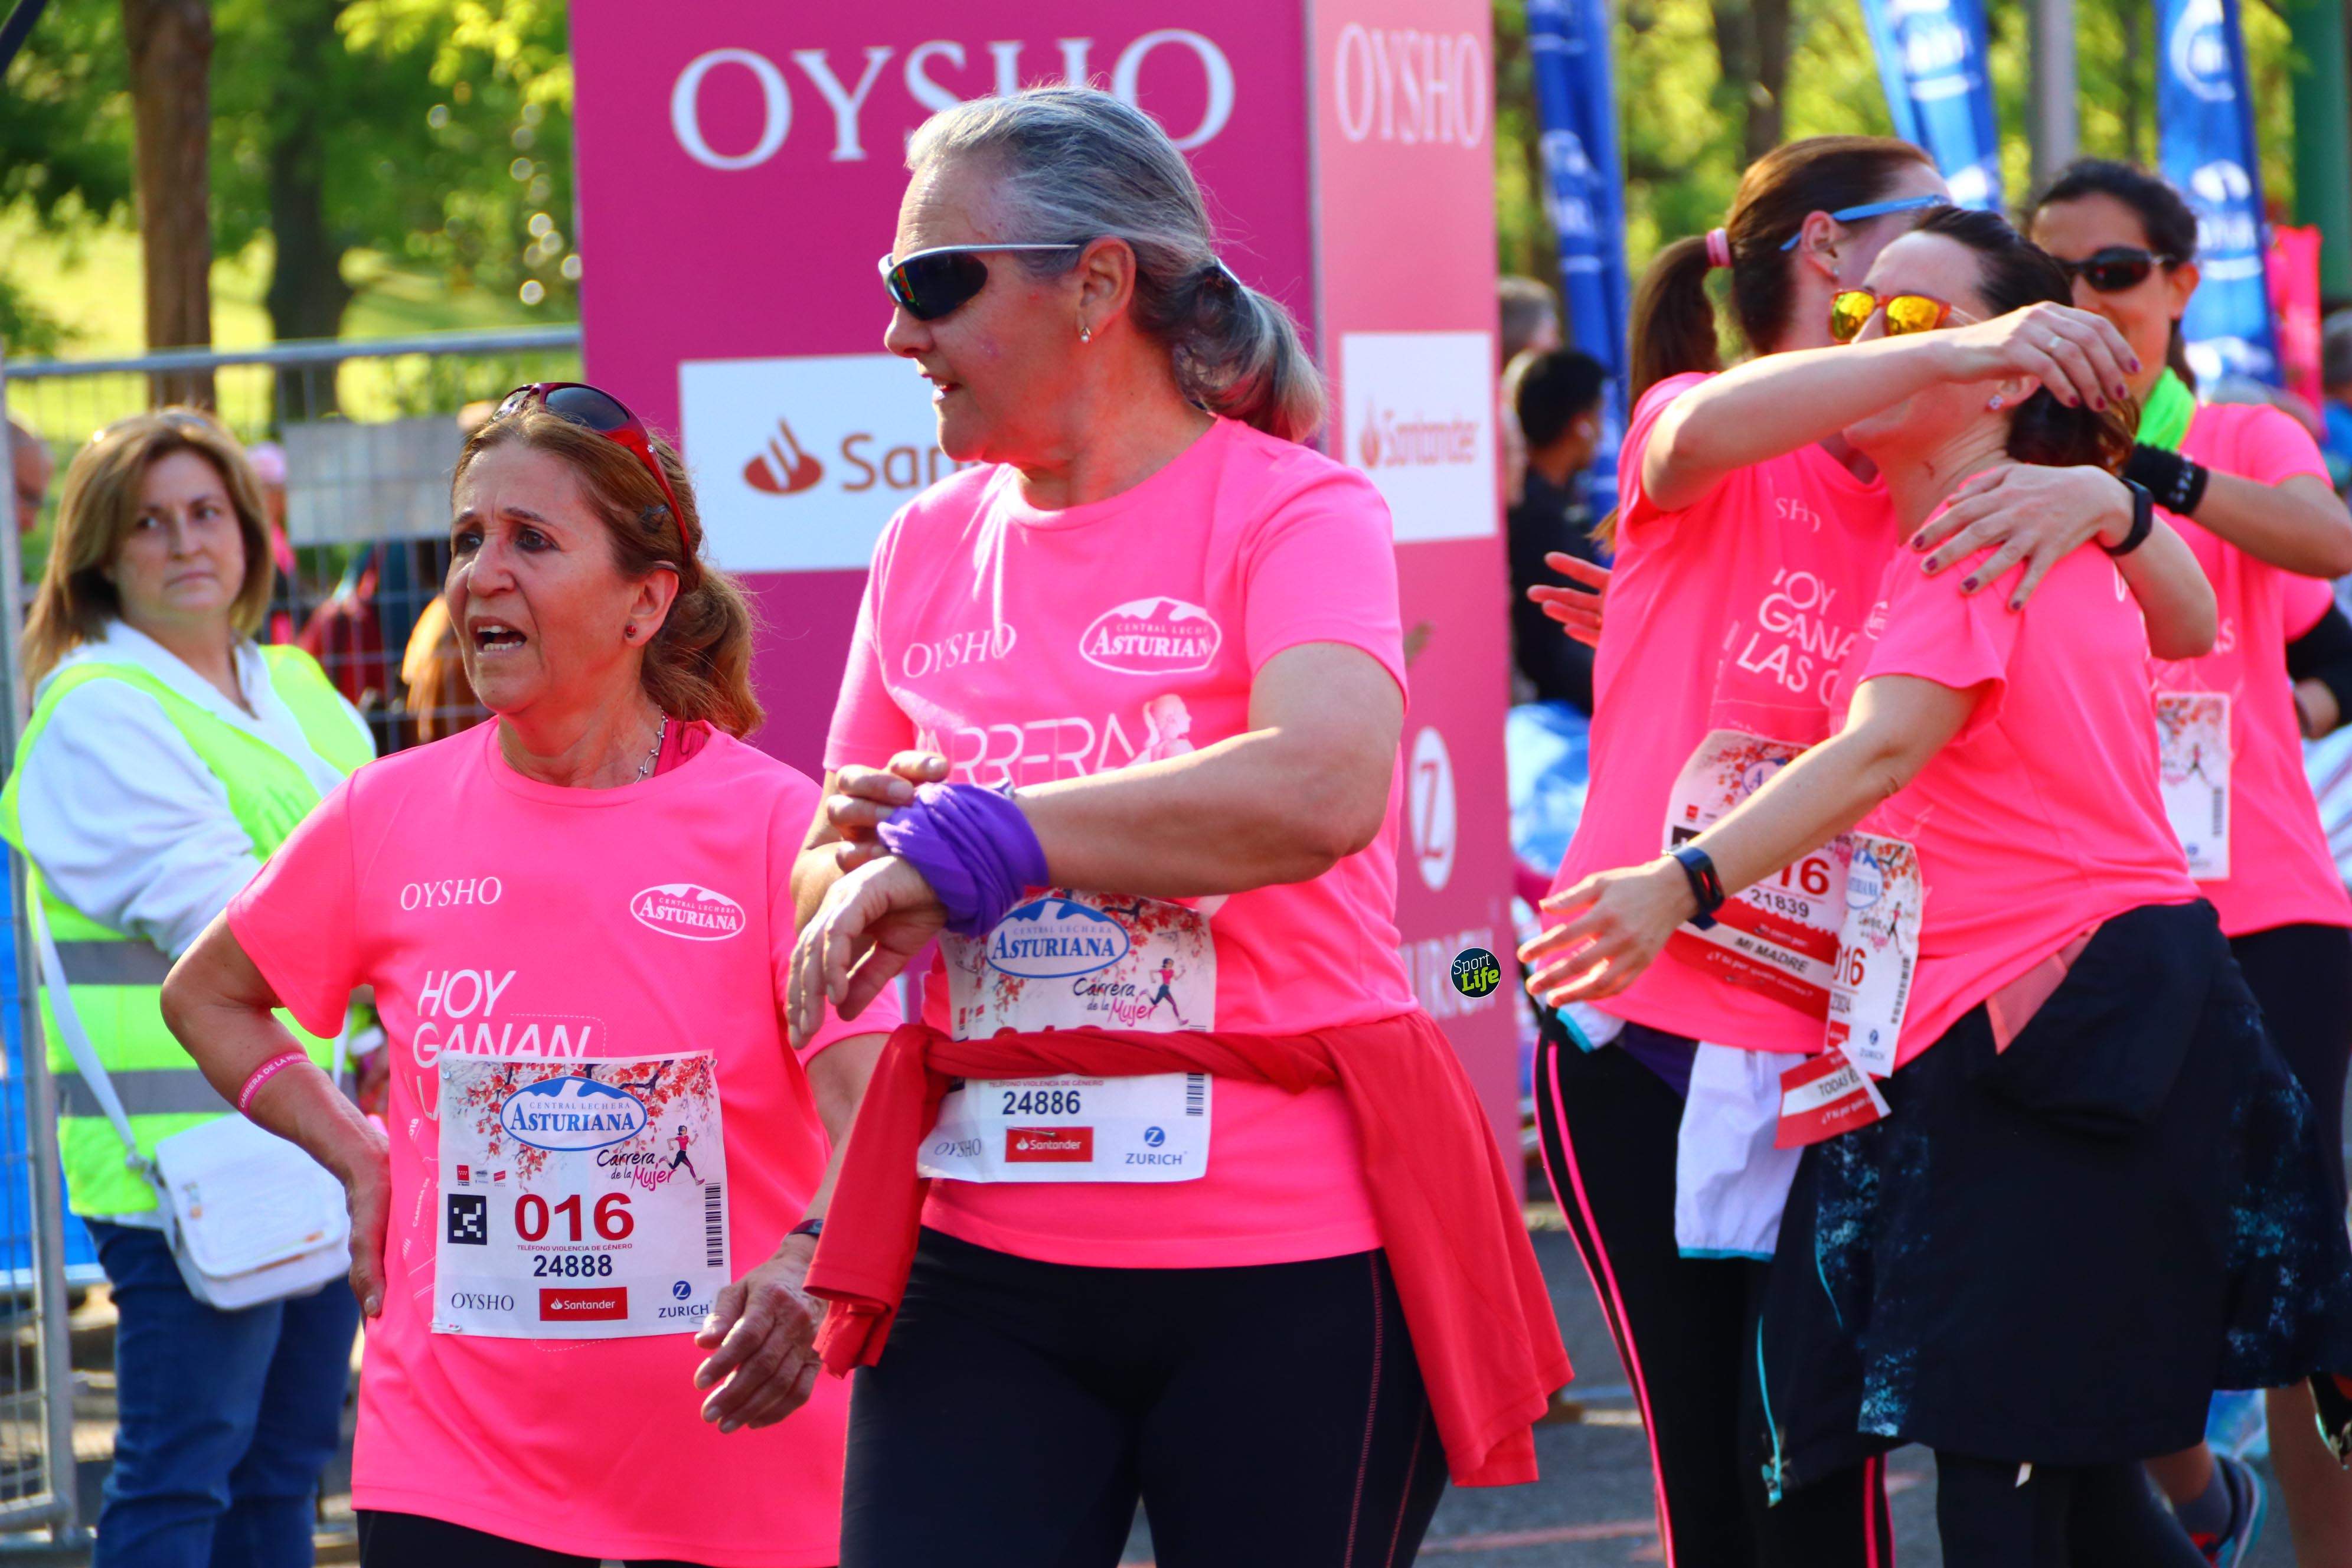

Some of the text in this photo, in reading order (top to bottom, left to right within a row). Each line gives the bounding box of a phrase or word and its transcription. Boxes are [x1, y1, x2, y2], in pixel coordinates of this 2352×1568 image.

[1334, 22, 1487, 148] OYSHO
[1384, 407, 1479, 467] Santander
[1116, 623, 1167, 634] CENTRAL
[902, 623, 1017, 678] OYSHO
[1736, 632, 1813, 693] LAS
[400, 877, 502, 911] OYSHO
[659, 897, 736, 914] CENTRAL LECHERA
[1750, 888, 1809, 918] 21839
[639, 896, 737, 930] ASTURIANA
[1013, 925, 1112, 935] CENTRAL LECHERA
[991, 930, 1116, 961] ASTURIANA
[1734, 937, 1809, 974] MI MADRE
[417, 969, 517, 1019] HOY
[1073, 977, 1136, 996] Carrera
[1087, 996, 1159, 1027] de la Mujer
[240, 1074, 264, 1109] CARRERA
[263, 1064, 275, 1075] DE
[275, 1058, 287, 1067] LA
[1002, 1090, 1081, 1115] 24886
[509, 1103, 636, 1132] ASTURIANA
[597, 1149, 655, 1167] Carrera
[935, 1138, 982, 1158] OYSHO
[1030, 1139, 1082, 1150] Santander
[1126, 1153, 1182, 1165] ZURICH
[611, 1164, 677, 1191] de la Mujer
[514, 1192, 635, 1242] 016
[603, 1243, 632, 1251] GÉNERO
[534, 1255, 613, 1278] 24888
[451, 1292, 514, 1312] OYSHO
[564, 1299, 616, 1311] Santander
[658, 1304, 709, 1318] ZURICH
